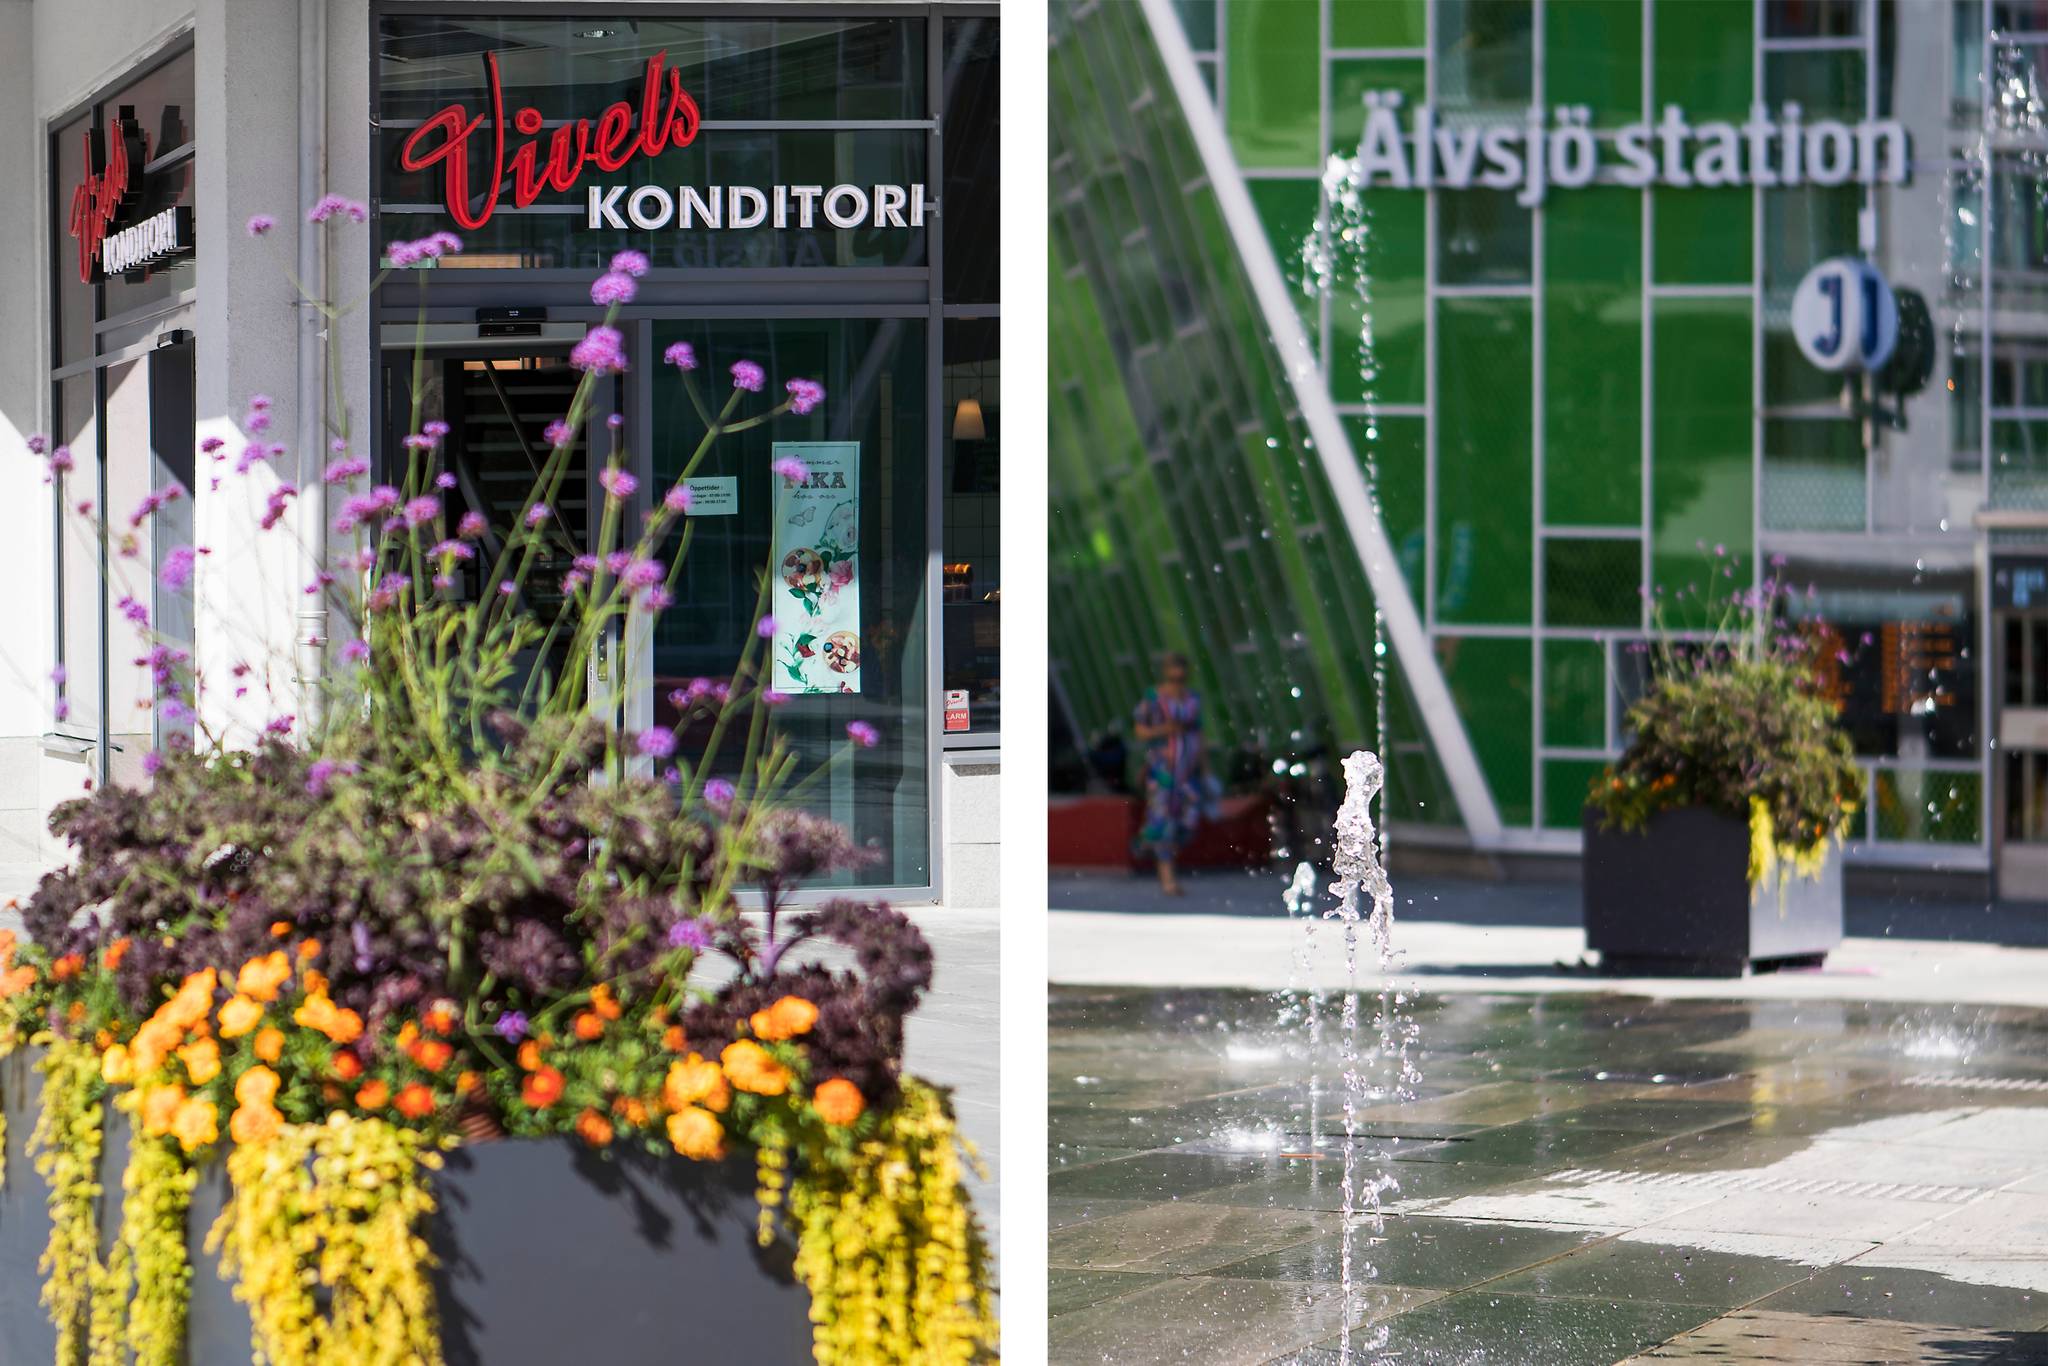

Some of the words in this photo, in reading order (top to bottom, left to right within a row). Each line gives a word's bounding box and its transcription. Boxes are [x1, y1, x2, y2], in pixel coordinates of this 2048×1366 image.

[401, 49, 701, 230] Vivels
[1359, 88, 1596, 207] Älvsjö
[1614, 102, 1907, 188] station
[588, 183, 925, 229] KONDITORI
